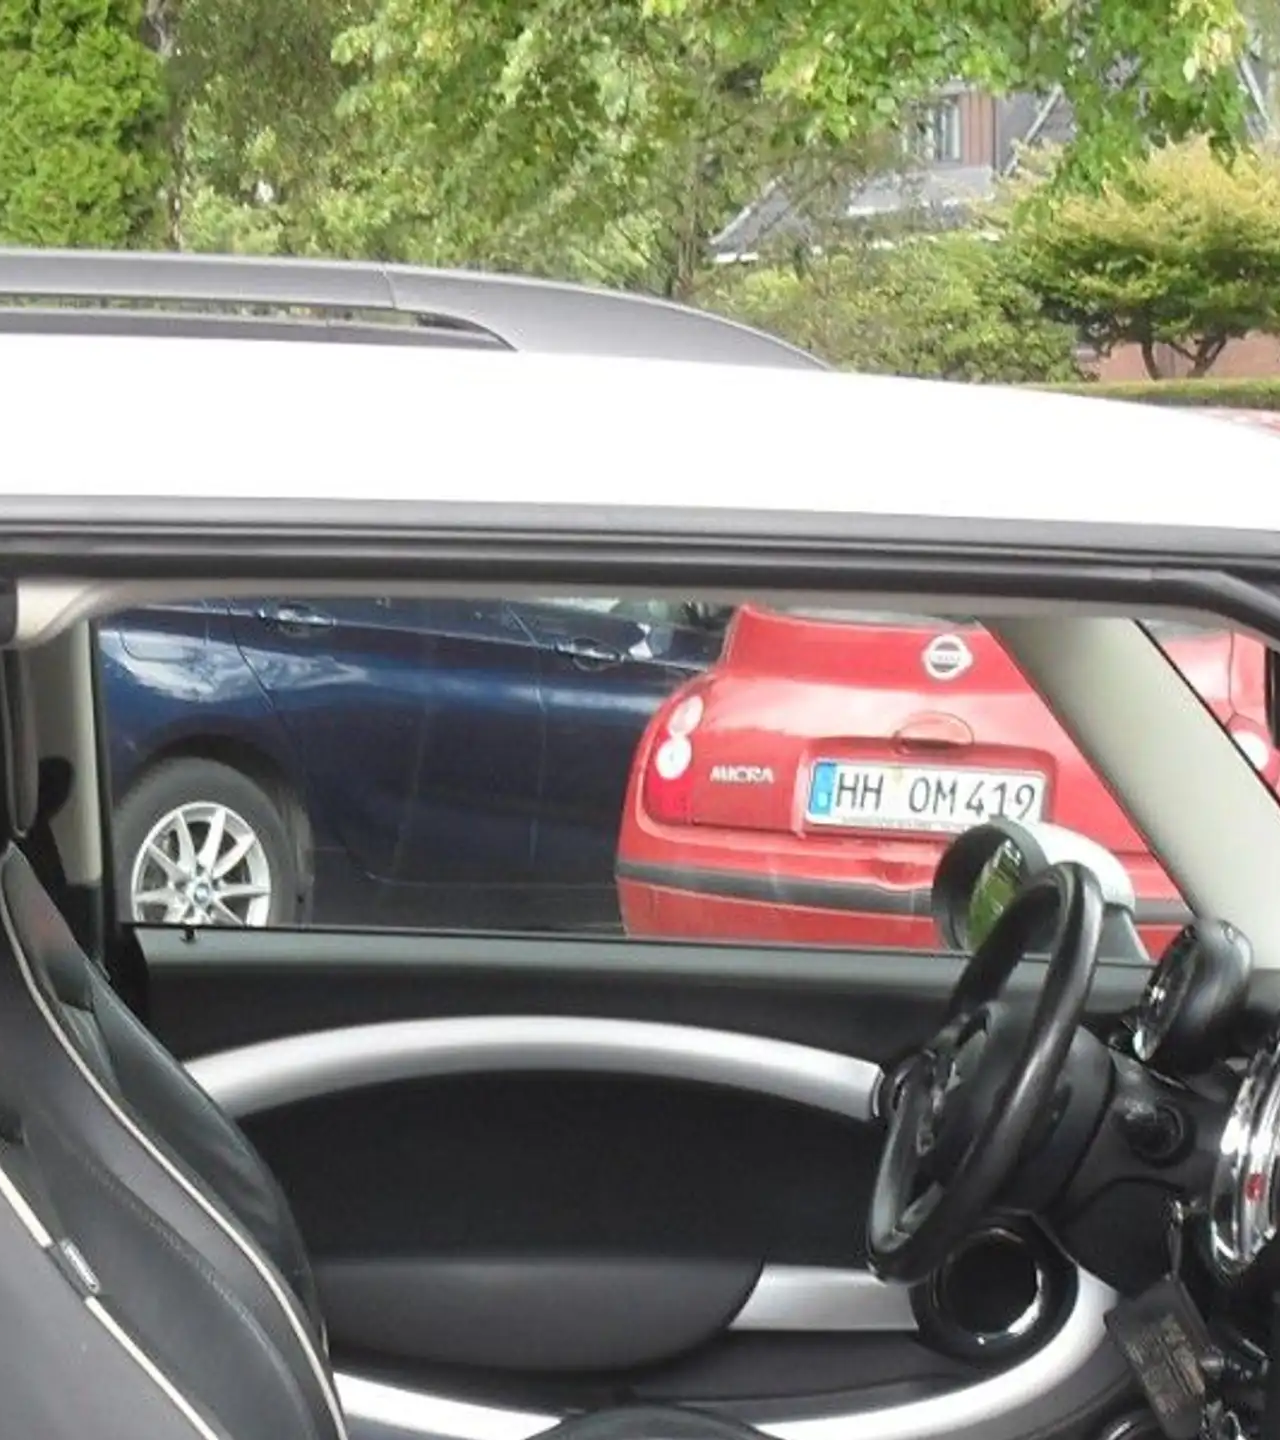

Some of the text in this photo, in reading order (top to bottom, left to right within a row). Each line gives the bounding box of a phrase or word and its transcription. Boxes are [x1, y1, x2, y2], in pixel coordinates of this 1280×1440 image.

[709, 765, 776, 784] MICRA
[836, 772, 1036, 821] HH OM 419
